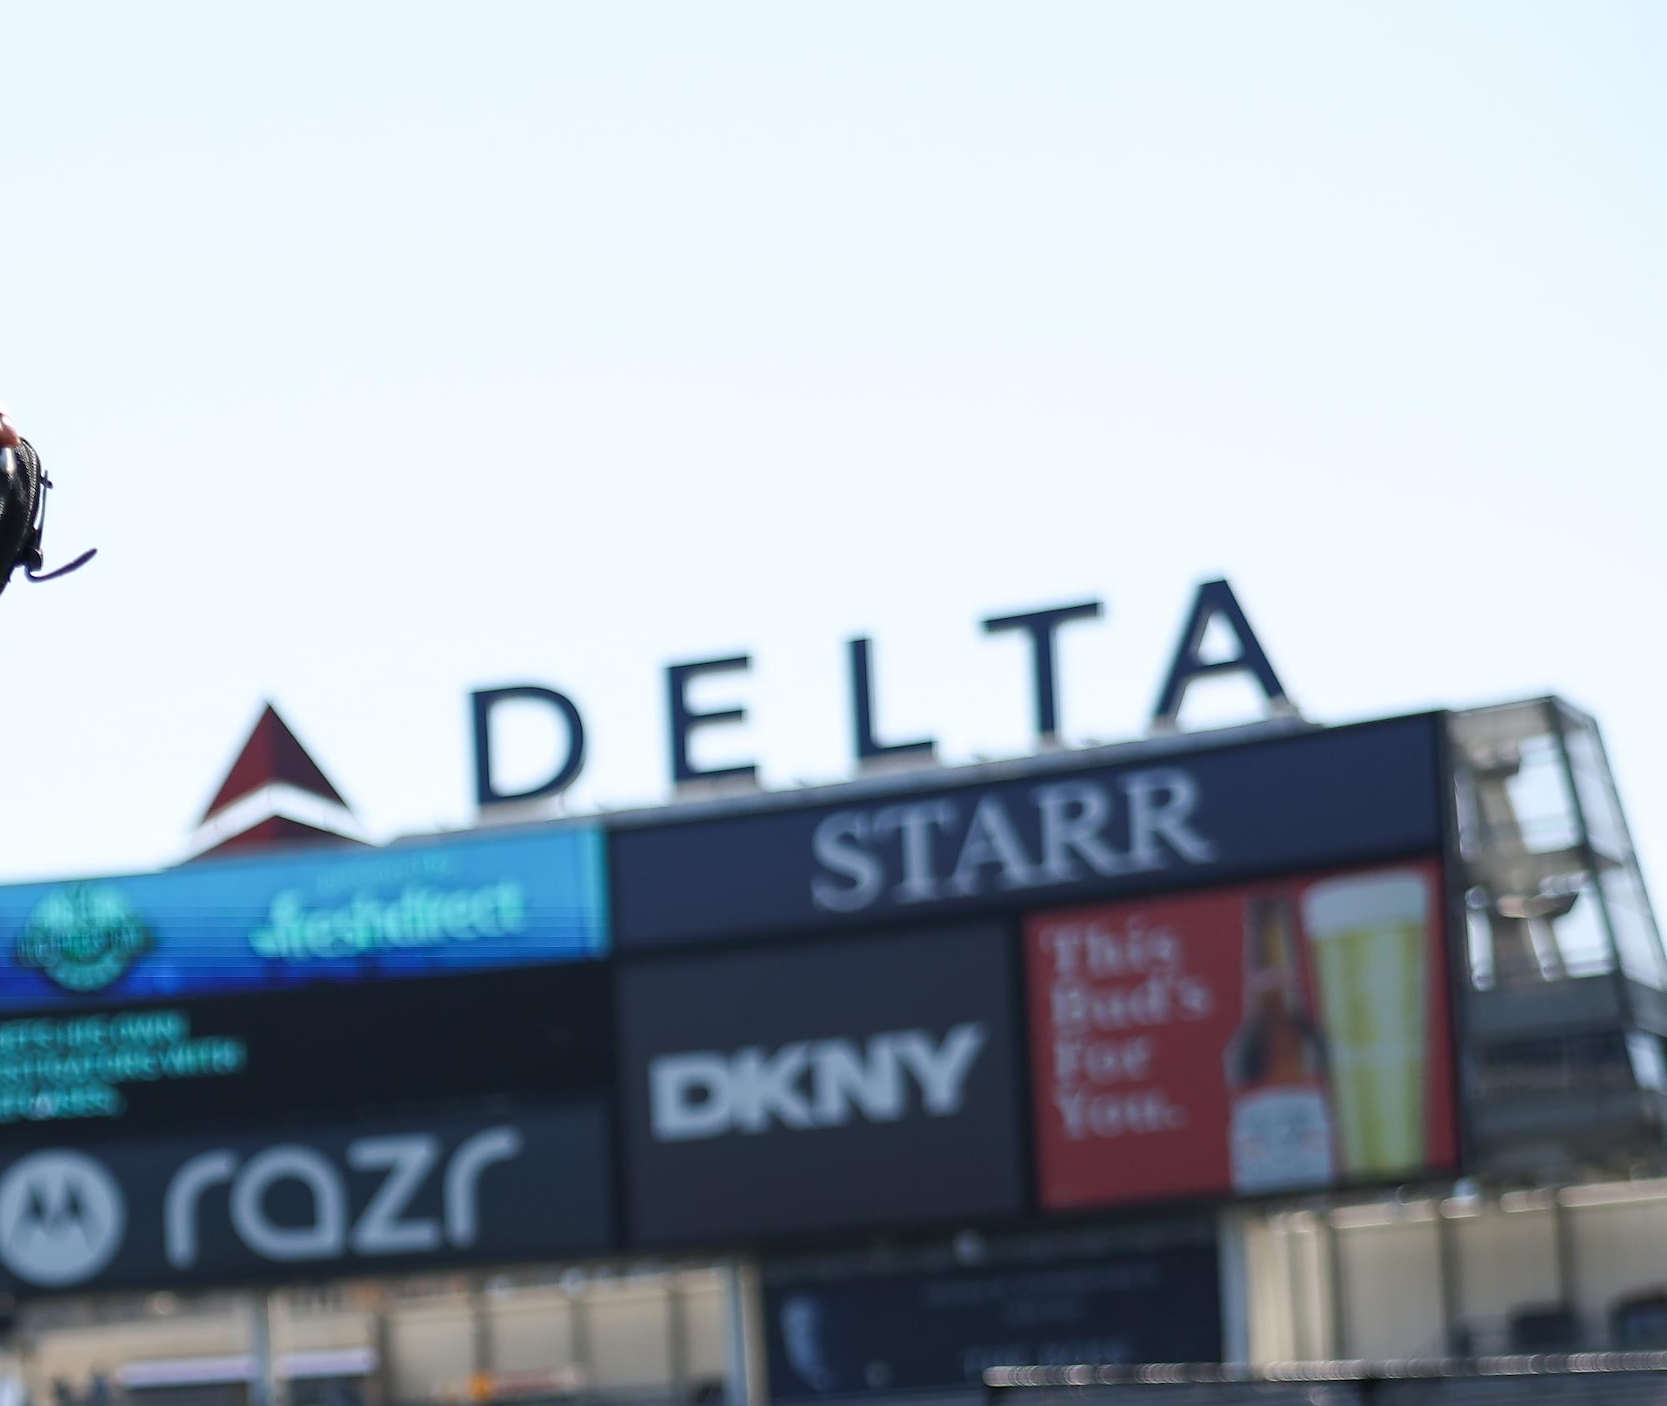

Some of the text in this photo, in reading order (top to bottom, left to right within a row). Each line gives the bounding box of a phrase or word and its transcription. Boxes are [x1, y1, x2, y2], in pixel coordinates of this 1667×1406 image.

[469, 577, 1301, 801] DELTA
[810, 766, 1219, 913] STARR
[1043, 911, 1179, 977] This
[1047, 970, 1213, 1035] Bud's
[649, 1022, 987, 1143] DKNY
[1053, 1030, 1151, 1086] For
[1057, 1088, 1186, 1141] You.
[162, 1126, 525, 1269] razr
